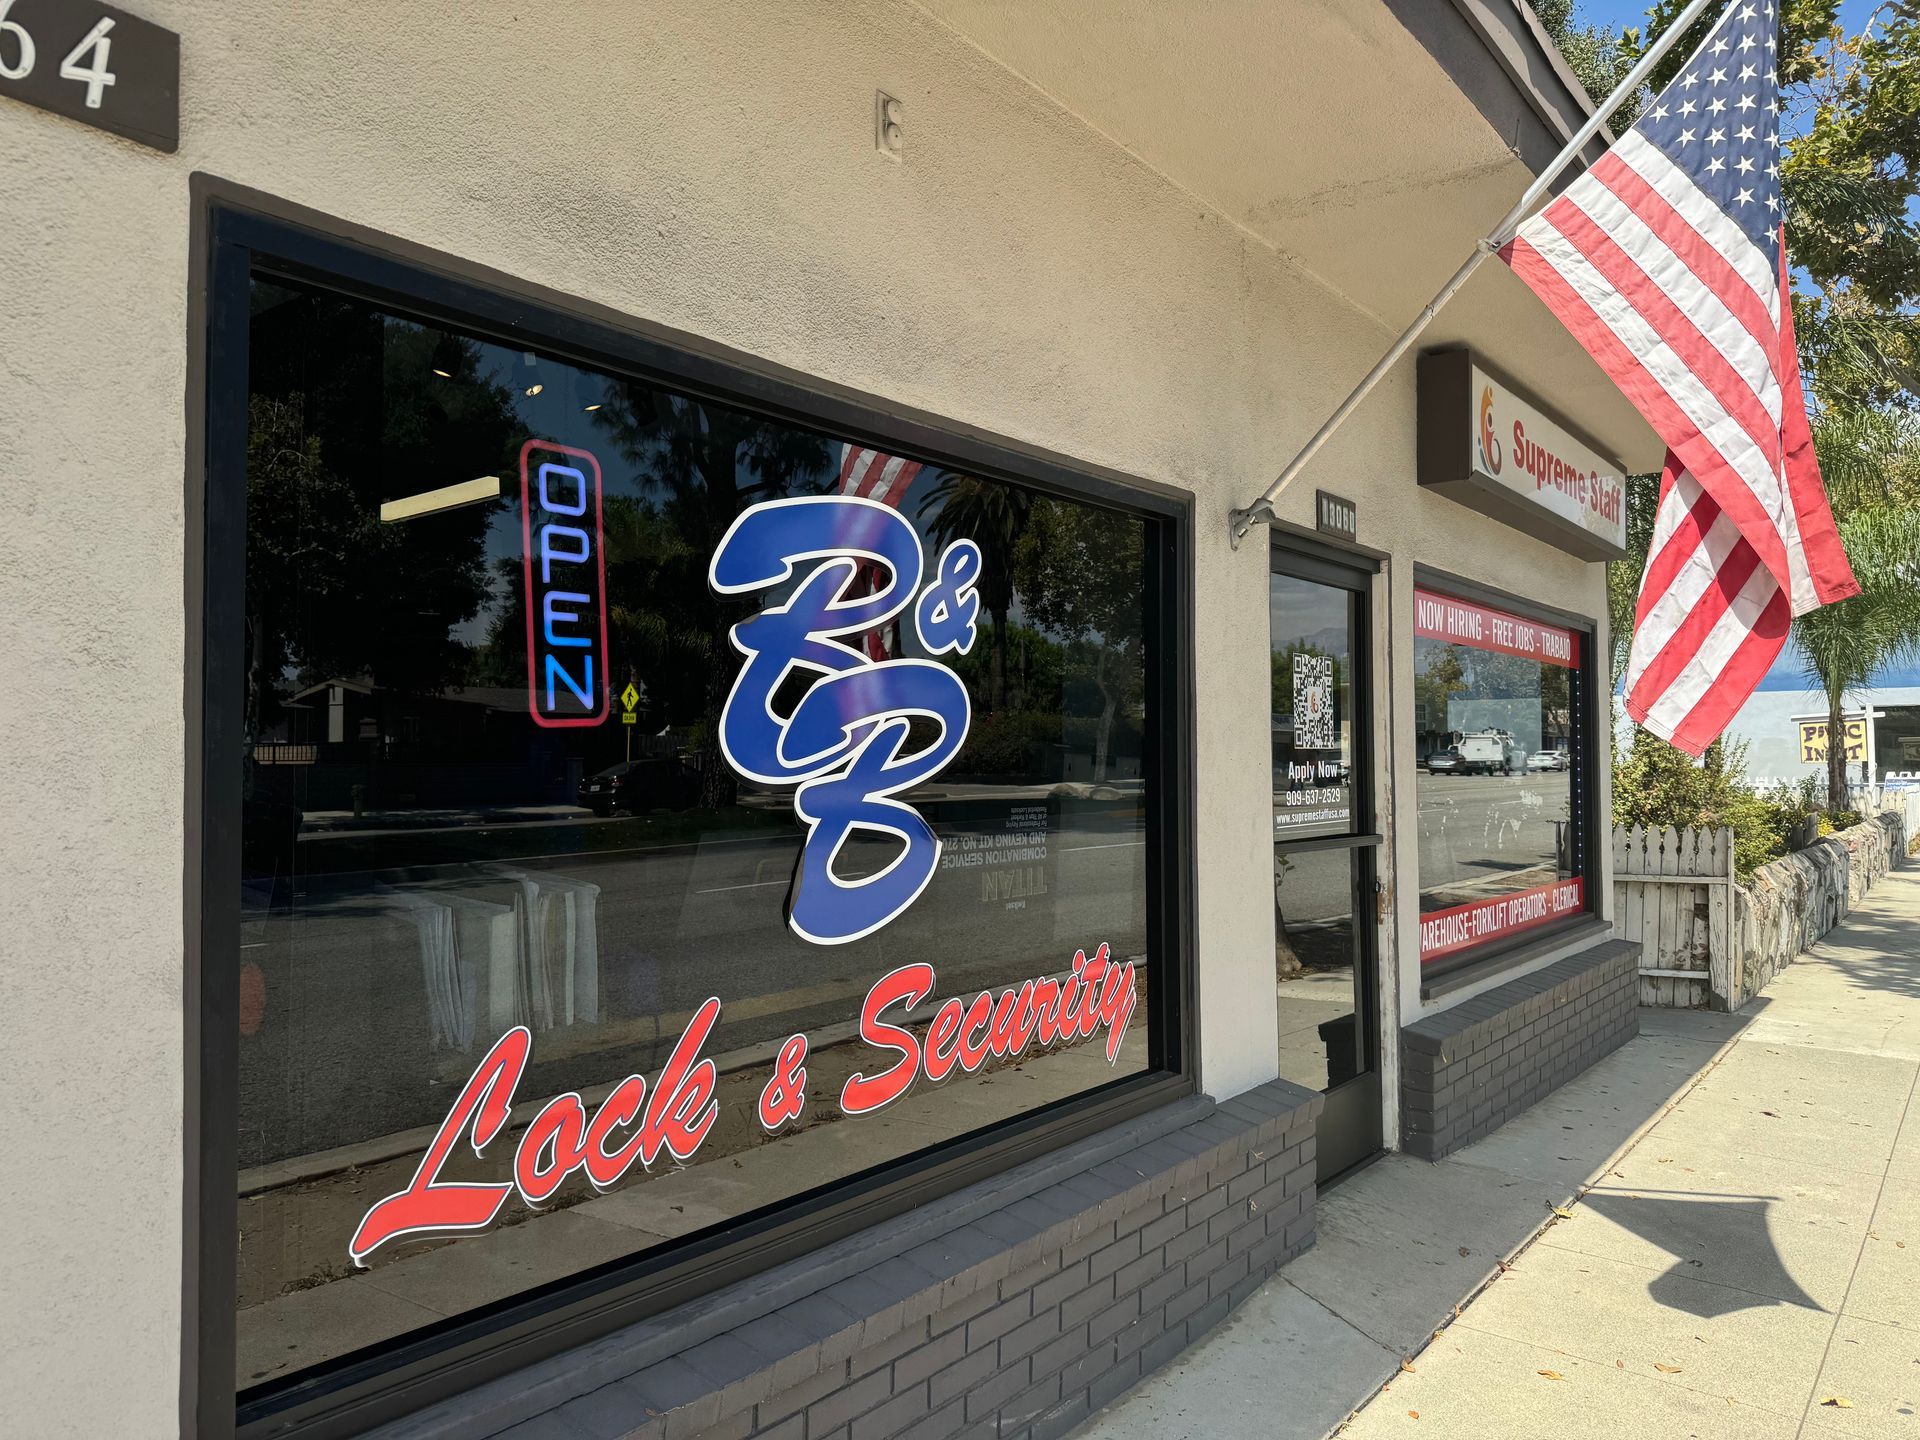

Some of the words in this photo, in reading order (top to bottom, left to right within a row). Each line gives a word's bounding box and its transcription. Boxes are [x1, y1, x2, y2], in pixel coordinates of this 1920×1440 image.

[1512, 419, 1586, 505] Supreme
[1590, 470, 1621, 525] Staff
[538, 462, 594, 711] OPEN
[1418, 599, 1444, 633] NOW
[1447, 606, 1482, 641] HIRING
[1492, 618, 1513, 648] FREE
[1514, 624, 1535, 653] JOBS
[1541, 631, 1571, 661] TRABAJO
[1288, 760, 1315, 783] Apply
[1317, 760, 1338, 778] Now
[1286, 787, 1341, 806] 909-637-2529
[1276, 808, 1350, 824] www.supremestaffusa.com
[978, 835, 994, 850] KIT
[995, 833, 1028, 848] KEYING
[1029, 831, 1047, 845] AND
[942, 852, 984, 870] SERVICE
[985, 846, 1048, 866] COMBINATION
[981, 866, 1048, 902] TITAN
[1508, 892, 1547, 926] OPERATORS
[1552, 884, 1580, 912] CLERICAL
[349, 996, 721, 1267] Lock
[758, 1032, 808, 1134] &
[840, 941, 1137, 1115] Security
